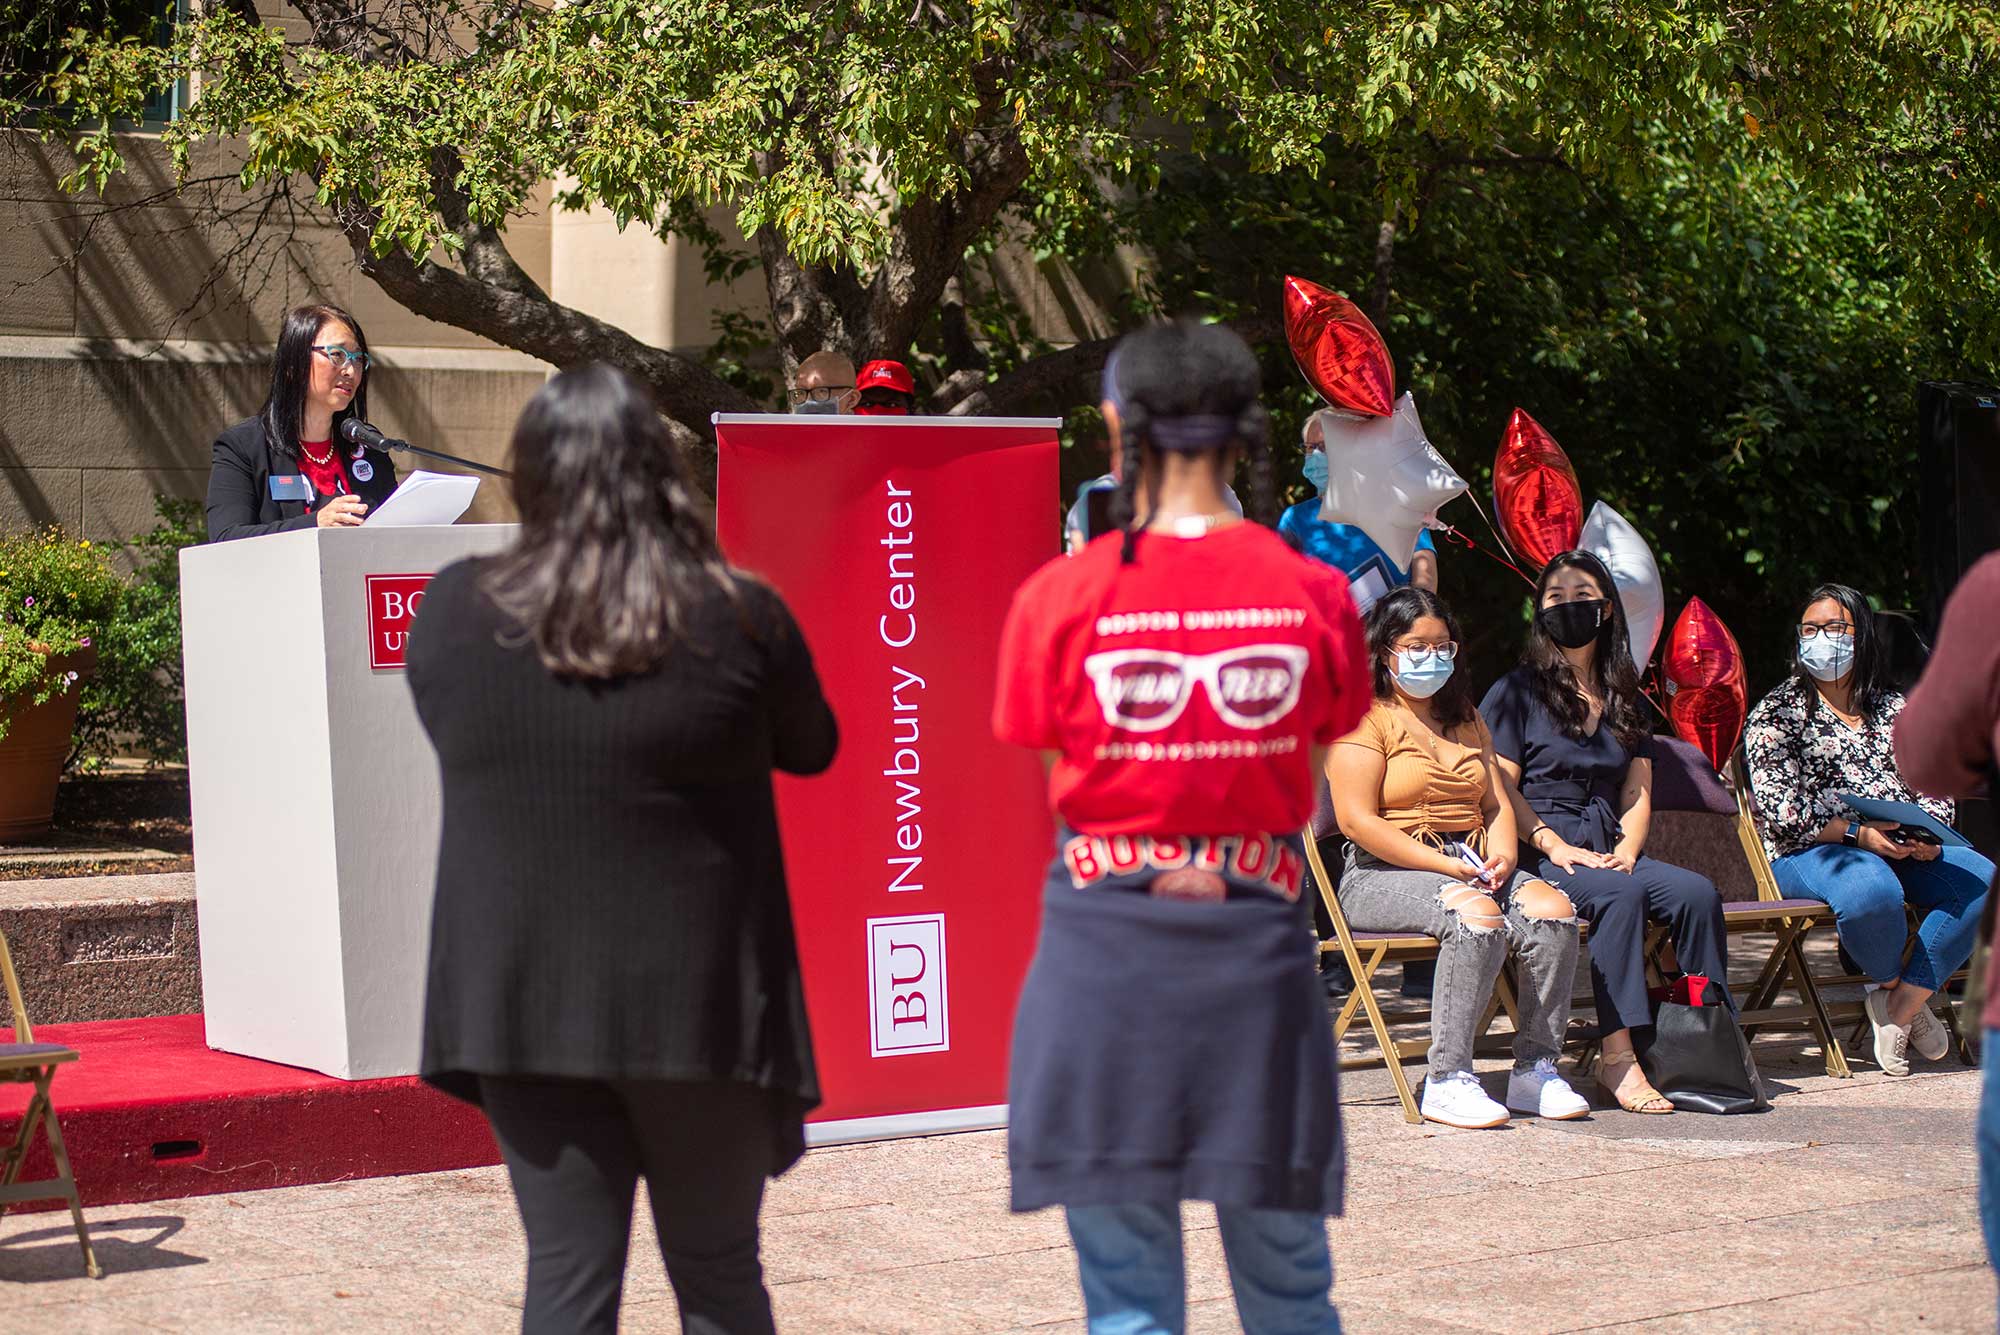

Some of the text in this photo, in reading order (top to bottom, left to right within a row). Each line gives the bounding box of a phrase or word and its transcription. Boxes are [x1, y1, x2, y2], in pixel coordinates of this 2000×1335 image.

[1096, 608, 1307, 636] BOSTON UNIVERSITY
[879, 479, 926, 892] Newbury Center
[1064, 831, 1305, 903] BOSTON
[890, 939, 928, 1032] BU
